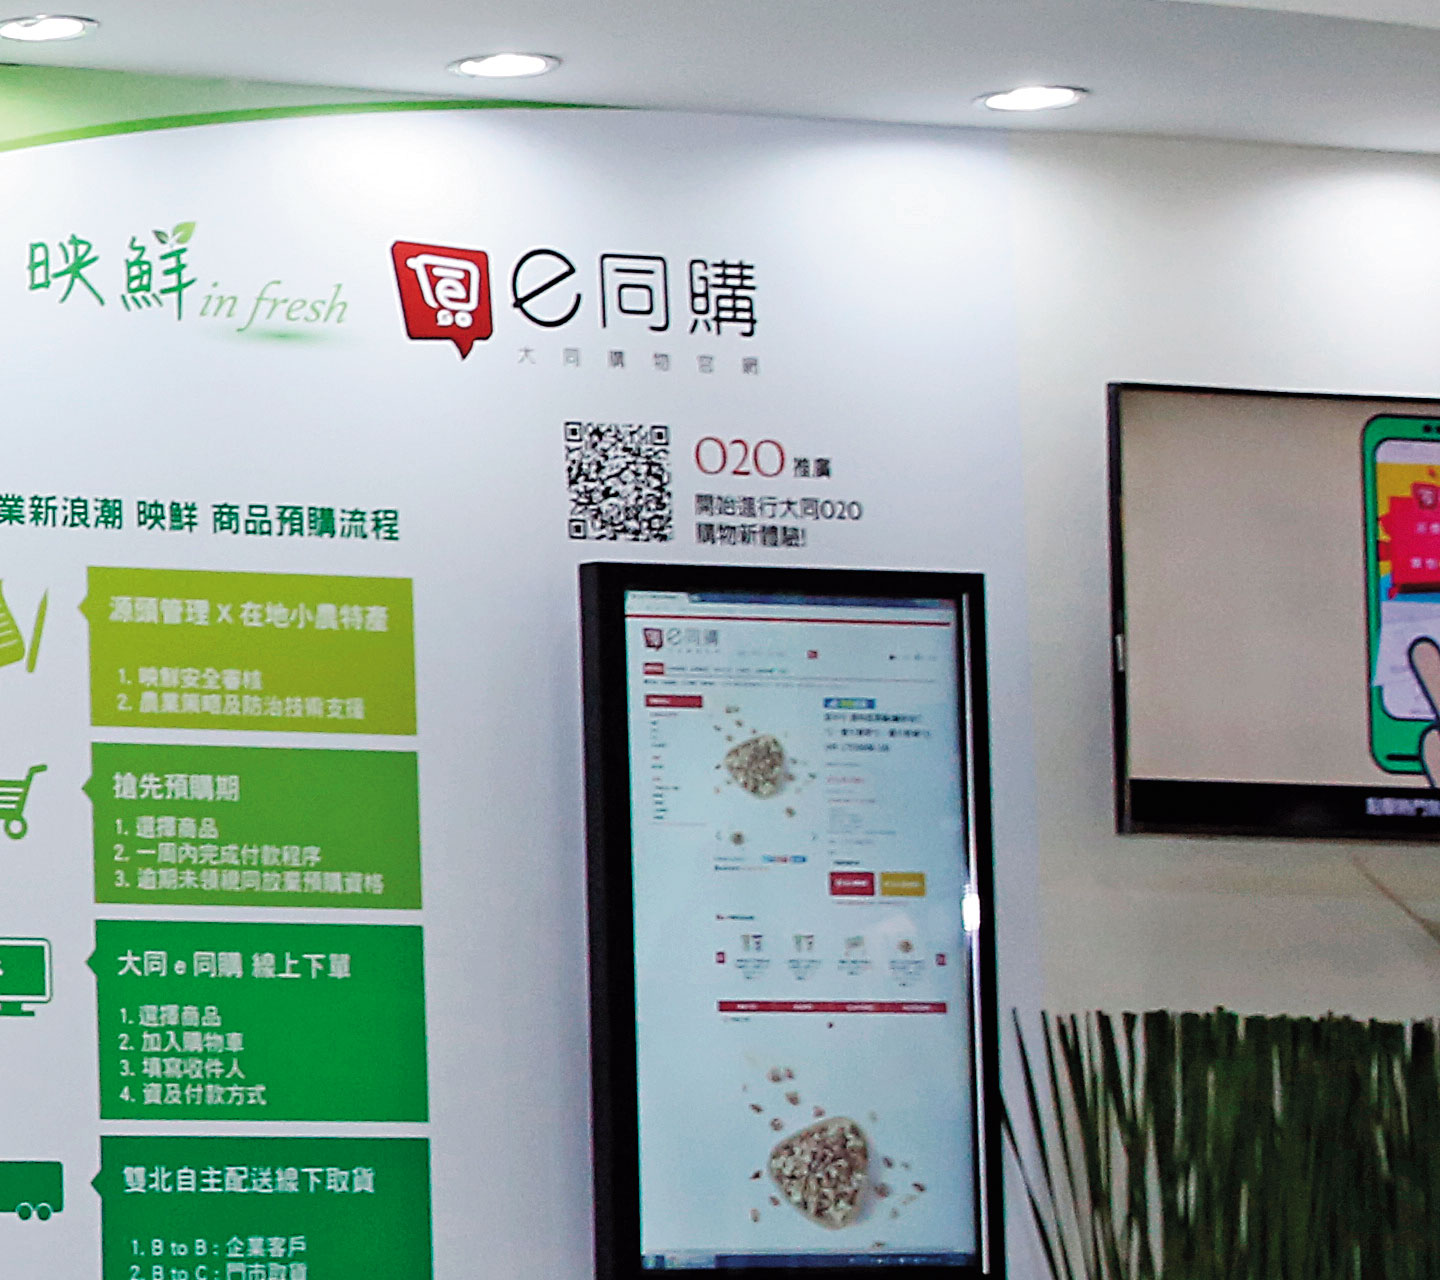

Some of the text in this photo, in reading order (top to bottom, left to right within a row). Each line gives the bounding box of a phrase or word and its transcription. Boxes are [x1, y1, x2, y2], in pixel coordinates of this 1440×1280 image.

[27, 224, 198, 321] 映鮮
[199, 280, 348, 332] in fresh
[136, 499, 198, 533] 映鮮
[211, 503, 400, 542] 商品預購流程
[113, 772, 240, 801] 搶先預購期
[117, 950, 351, 979] 大同 e 同購 線上下單
[141, 1031, 245, 1053] 加入購物車
[151, 1239, 164, 1256] B
[170, 1241, 188, 1256] to
